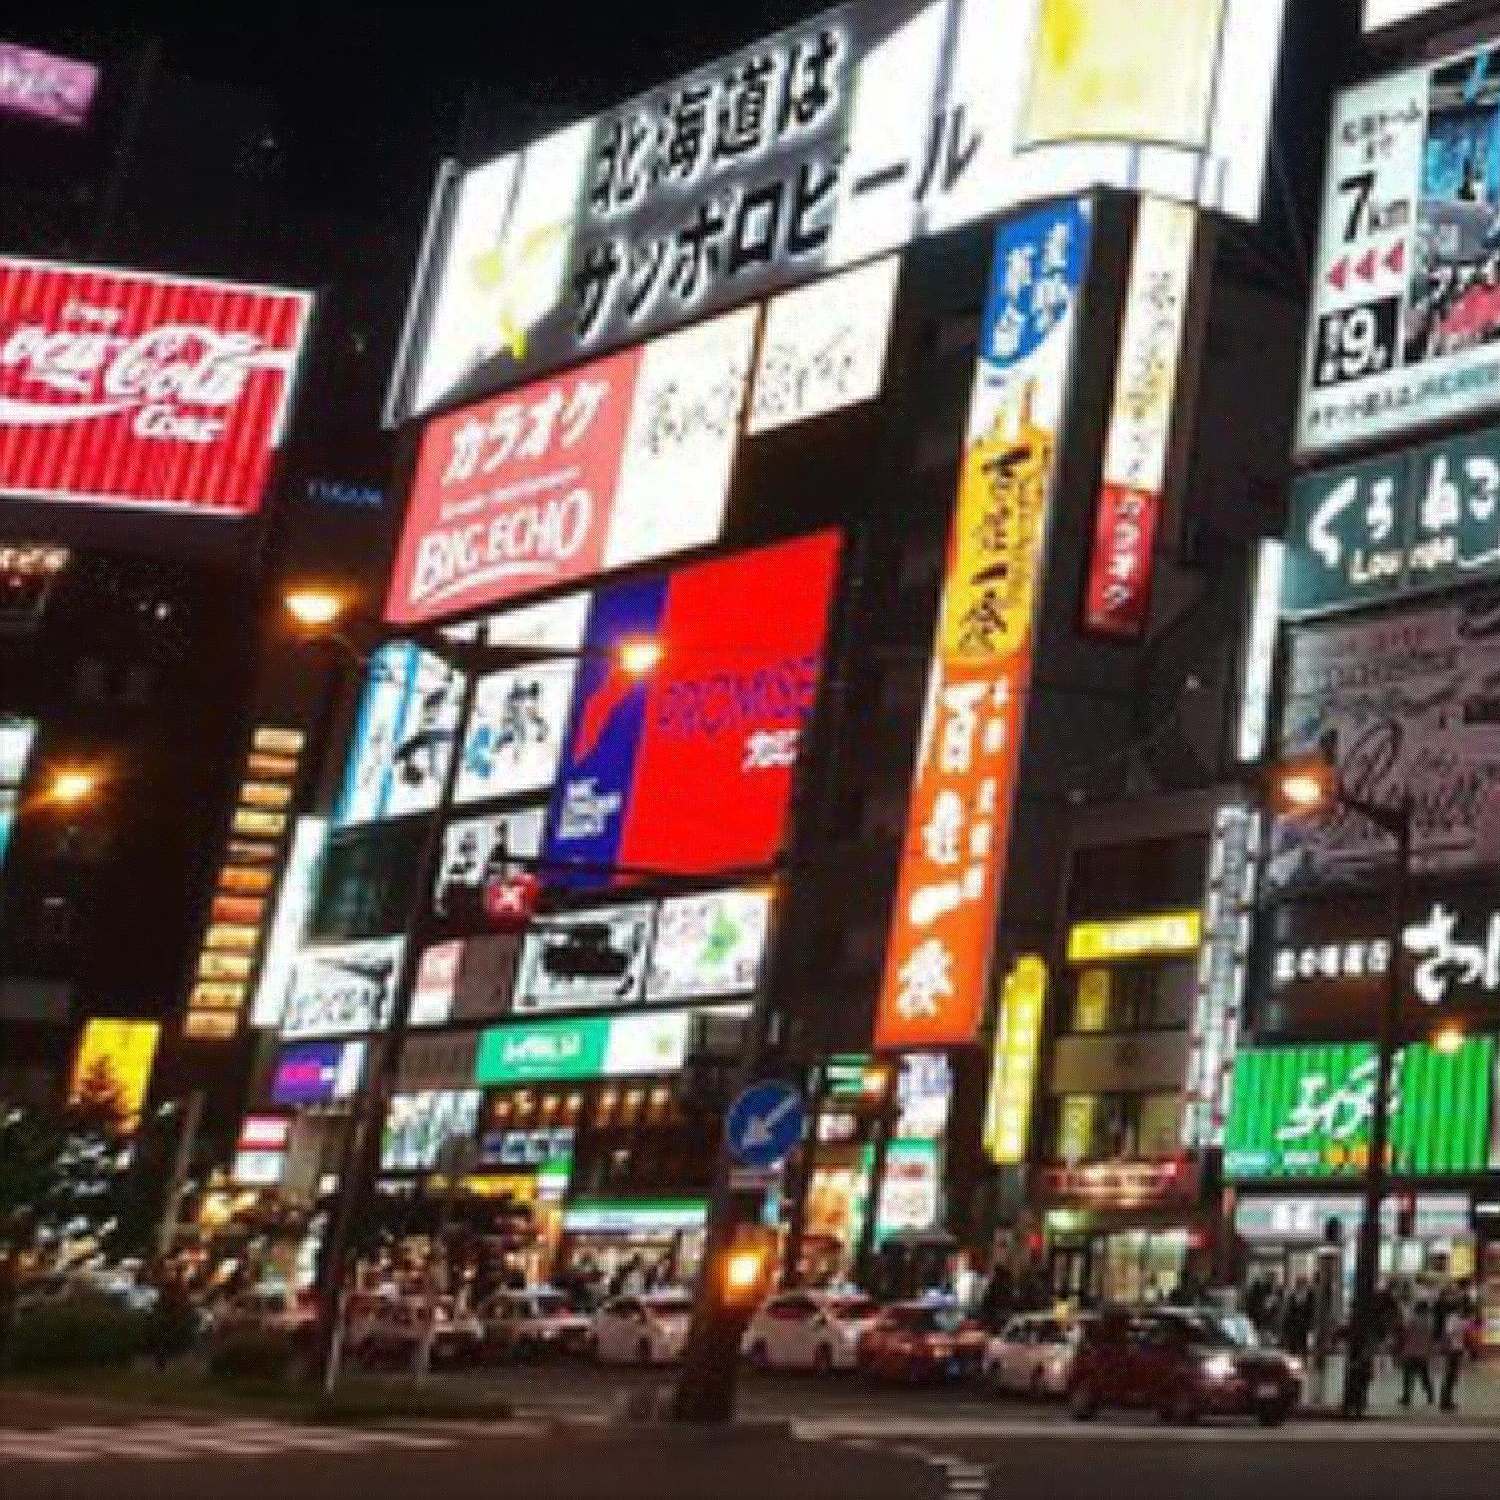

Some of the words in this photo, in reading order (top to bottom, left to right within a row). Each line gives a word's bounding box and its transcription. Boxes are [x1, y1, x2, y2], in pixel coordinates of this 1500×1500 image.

[590, 26, 849, 218] 北海道は
[439, 374, 613, 488] カラオケ
[412, 520, 486, 596] BIG
[487, 486, 594, 562] ECHO
